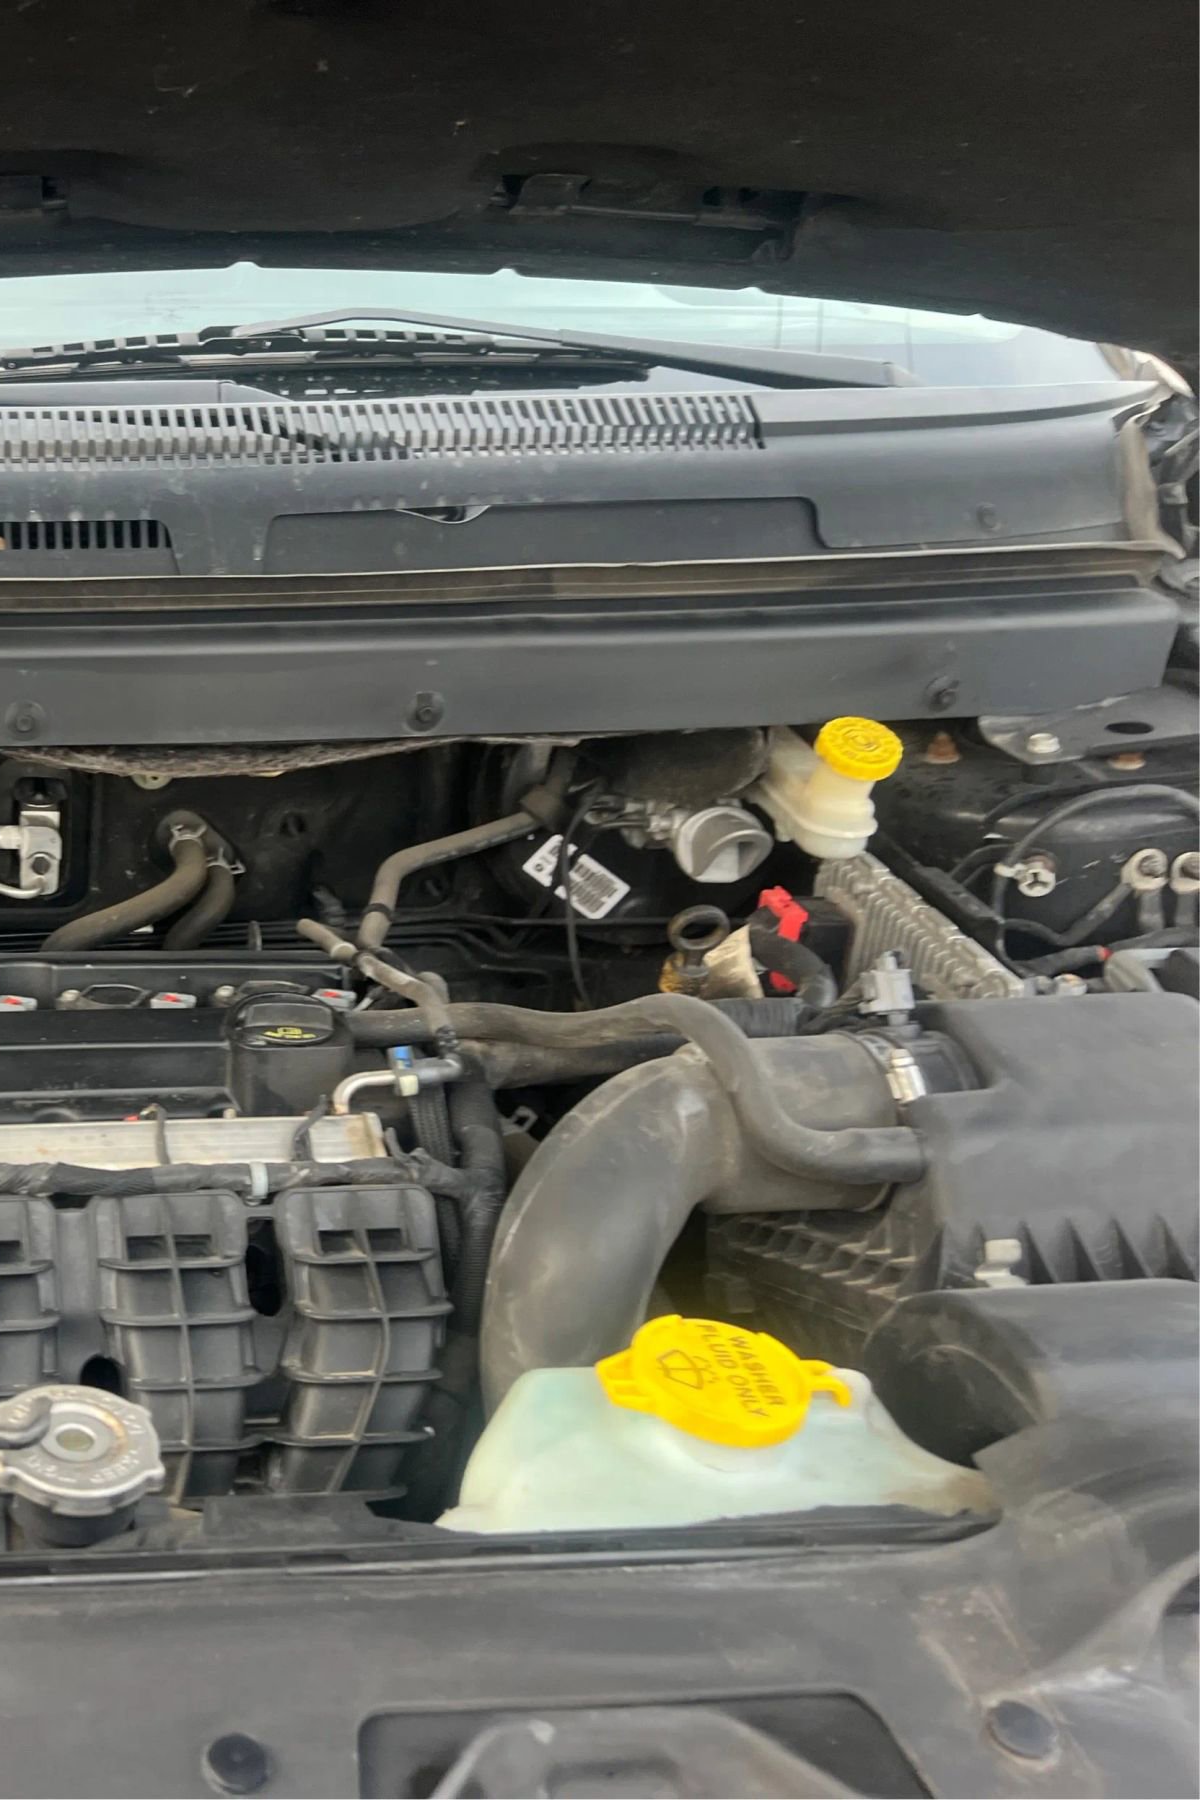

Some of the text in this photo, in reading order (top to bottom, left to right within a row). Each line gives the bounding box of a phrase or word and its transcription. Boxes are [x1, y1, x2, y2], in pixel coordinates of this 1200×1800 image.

[696, 1324, 770, 1417] FLUID ONLY
[728, 1335, 787, 1406] WASHER
